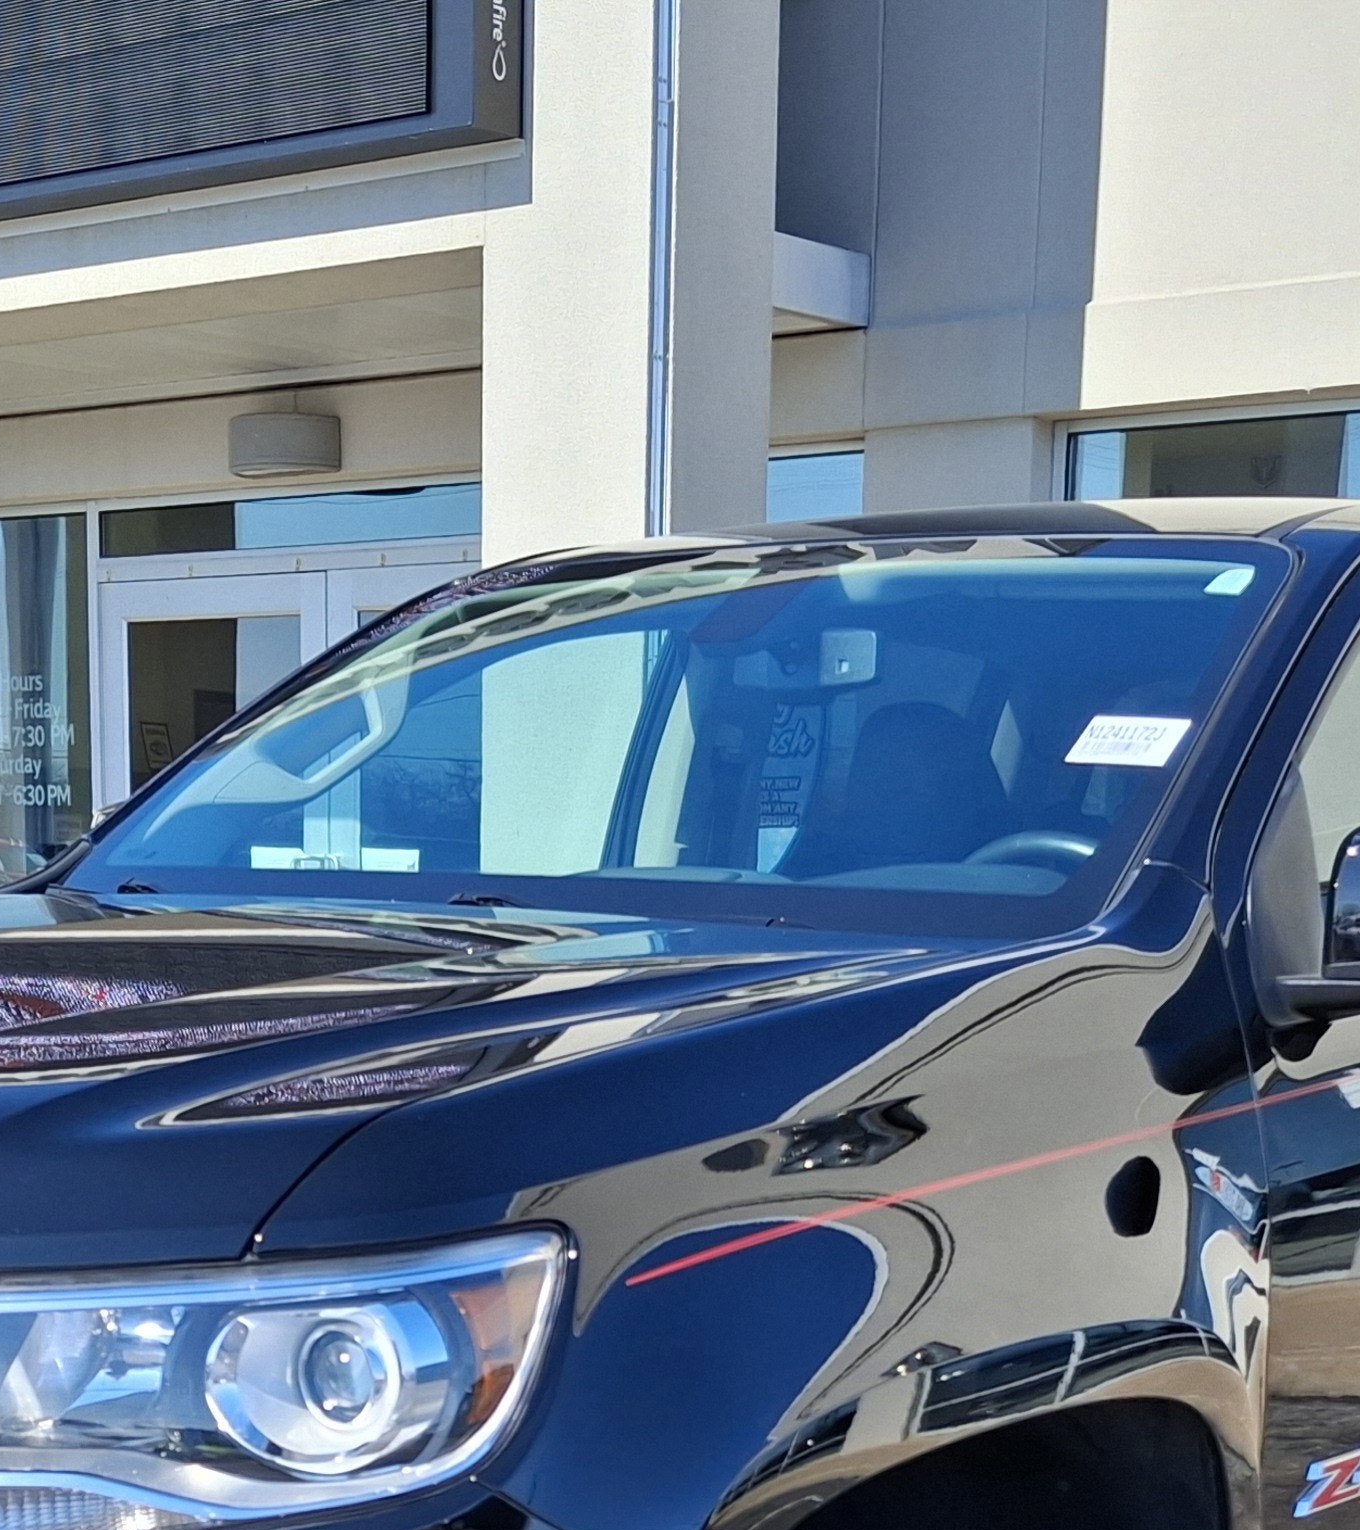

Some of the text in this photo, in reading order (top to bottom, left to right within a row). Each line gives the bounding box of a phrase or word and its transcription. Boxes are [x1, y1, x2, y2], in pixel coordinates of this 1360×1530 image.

[14, 698, 60, 723] Friday
[12, 725, 45, 747] 7:30
[51, 723, 74, 746] PM
[47, 784, 72, 806] PM
